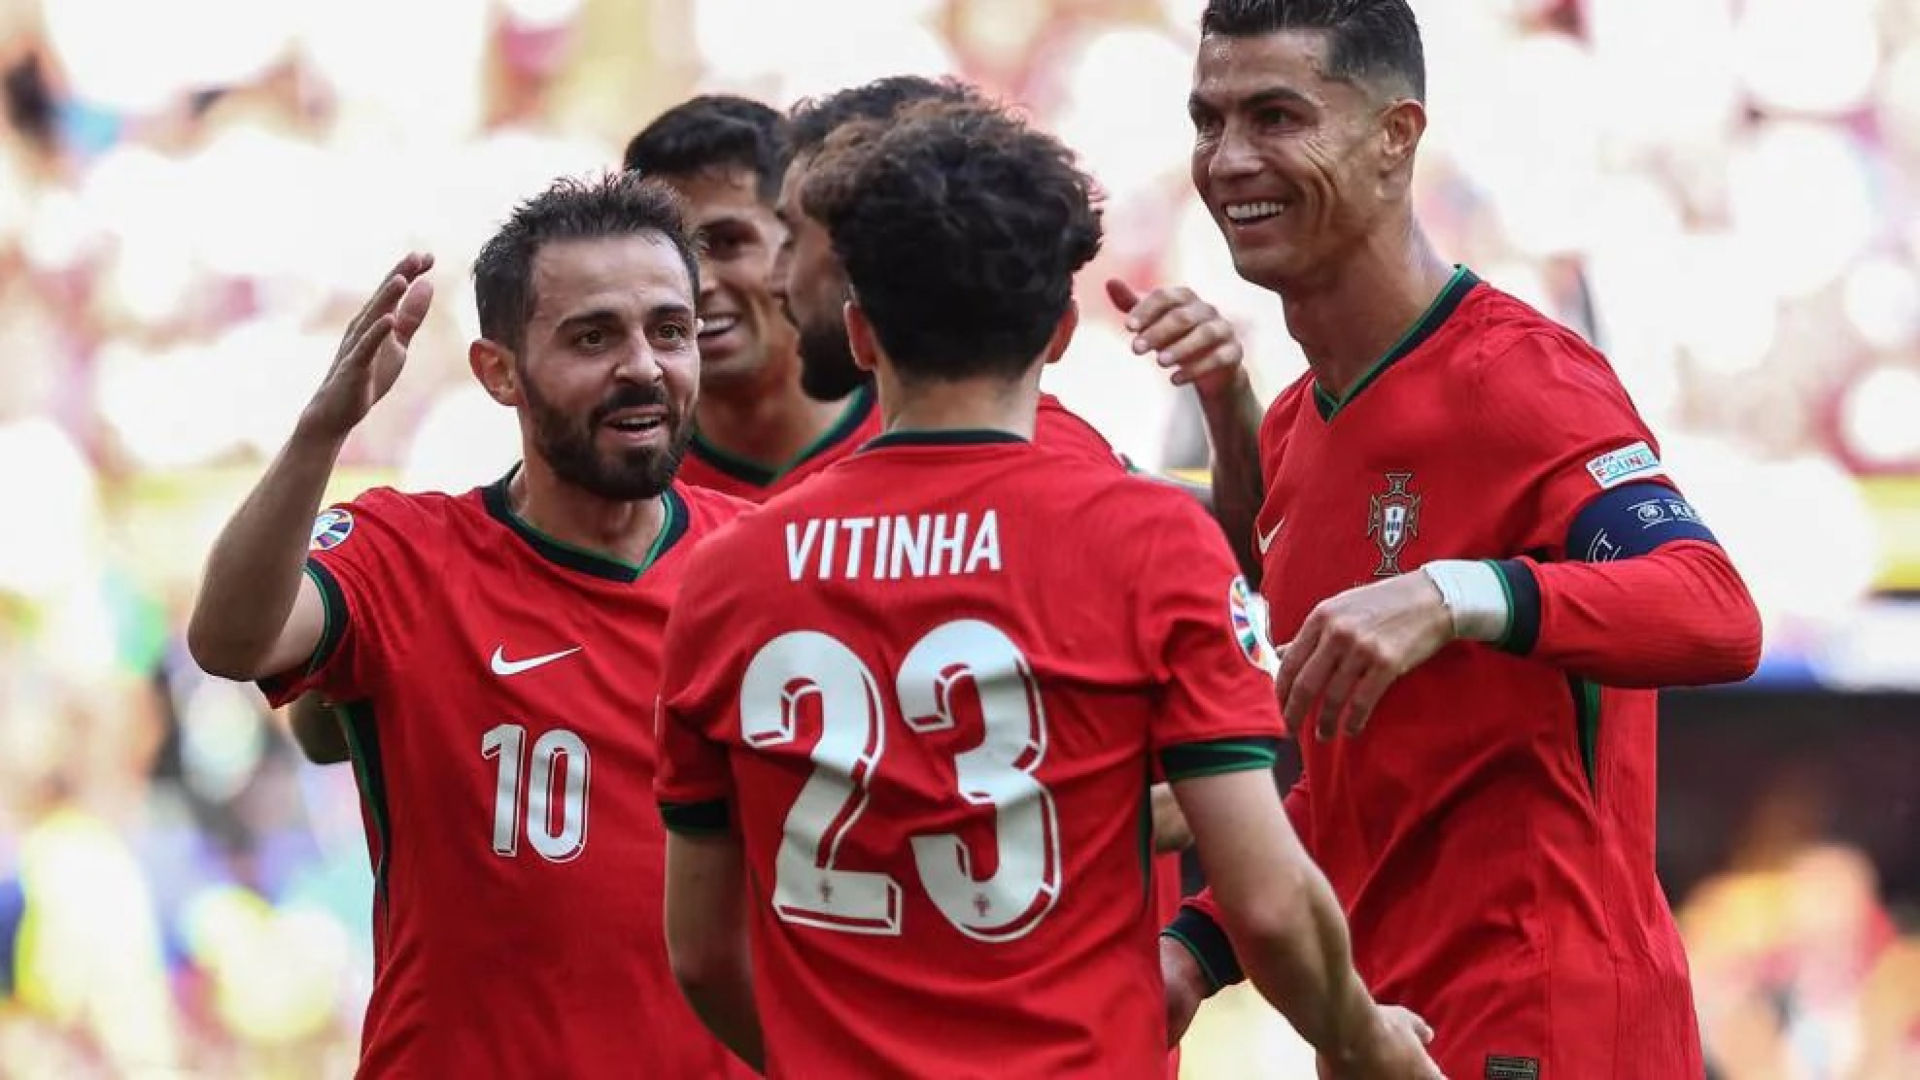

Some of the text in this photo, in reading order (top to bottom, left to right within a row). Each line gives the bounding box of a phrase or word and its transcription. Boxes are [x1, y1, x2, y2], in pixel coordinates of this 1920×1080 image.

[785, 510, 1001, 581] VITINHA
[482, 724, 591, 863] 10
[740, 619, 1061, 942] 23
